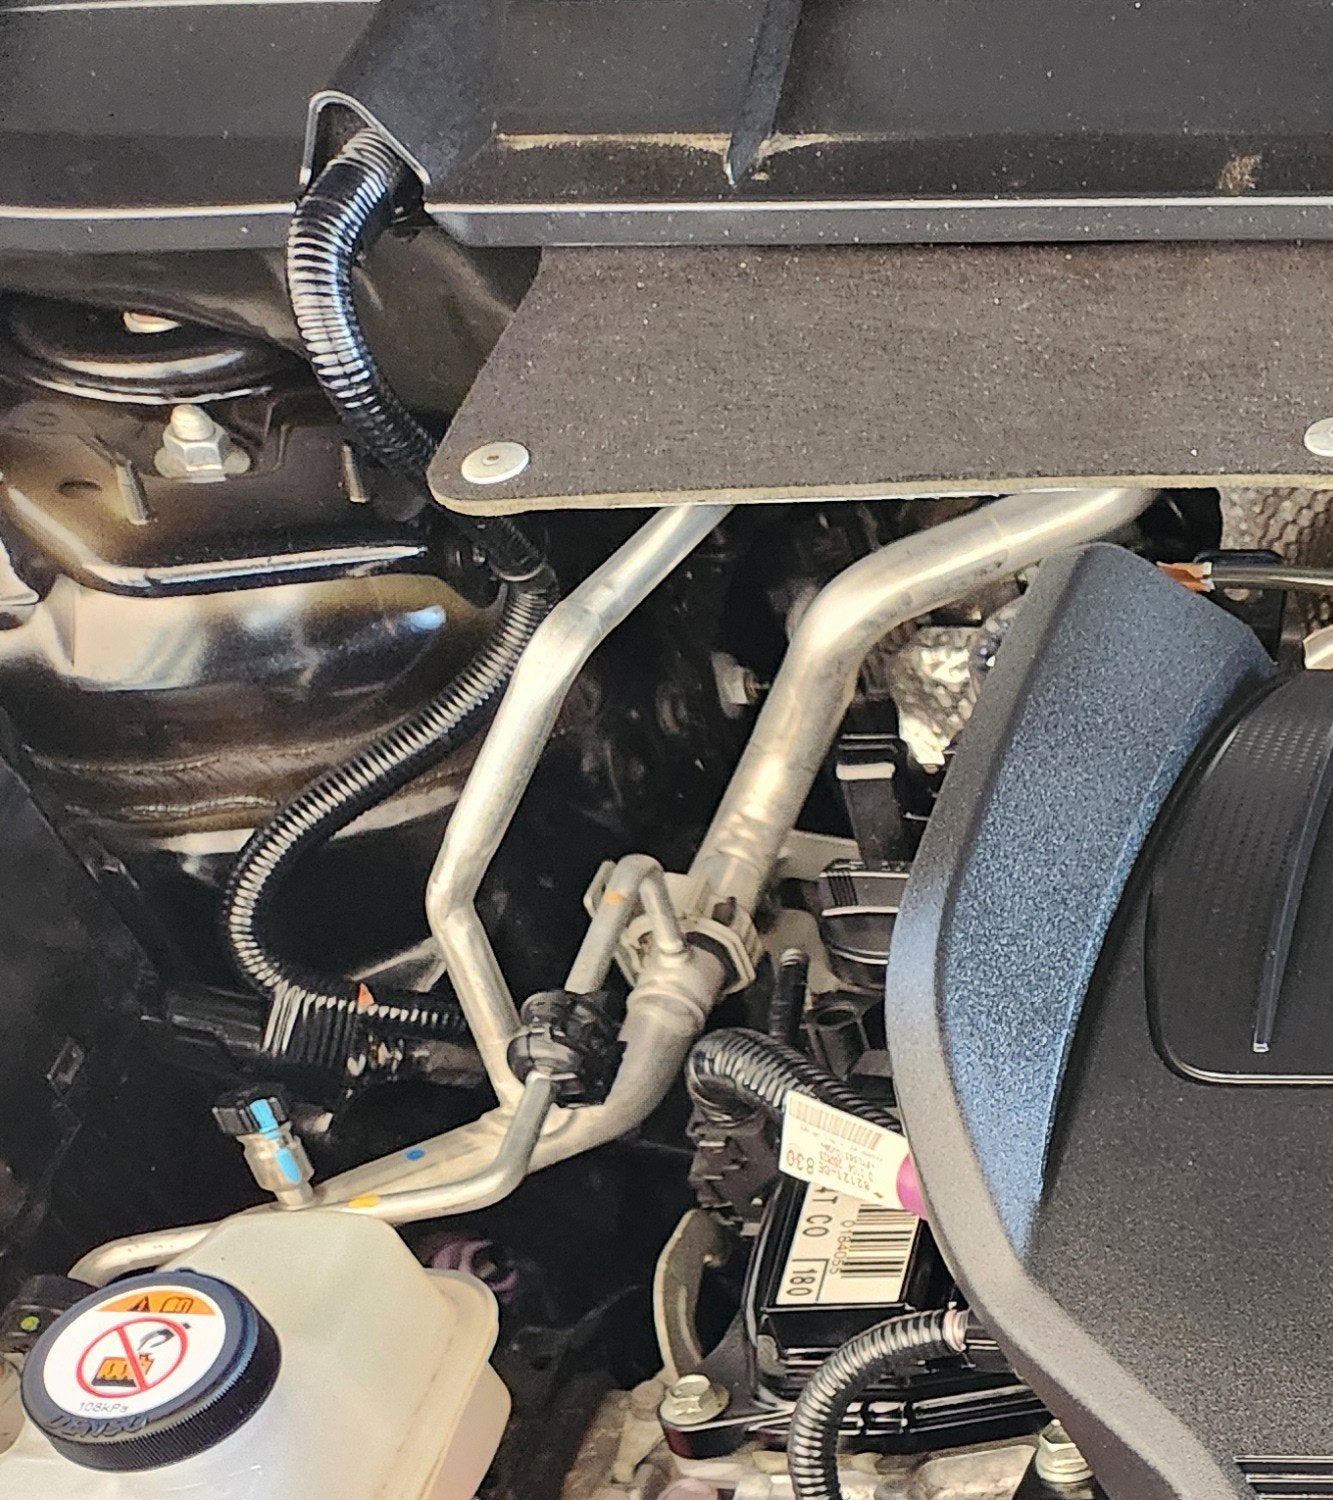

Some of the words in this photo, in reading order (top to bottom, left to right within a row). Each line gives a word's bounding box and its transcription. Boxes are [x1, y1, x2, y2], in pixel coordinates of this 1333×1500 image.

[802, 1214, 833, 1237] CO
[786, 1268, 818, 1297] 180
[78, 1401, 129, 1414] 108kPa
